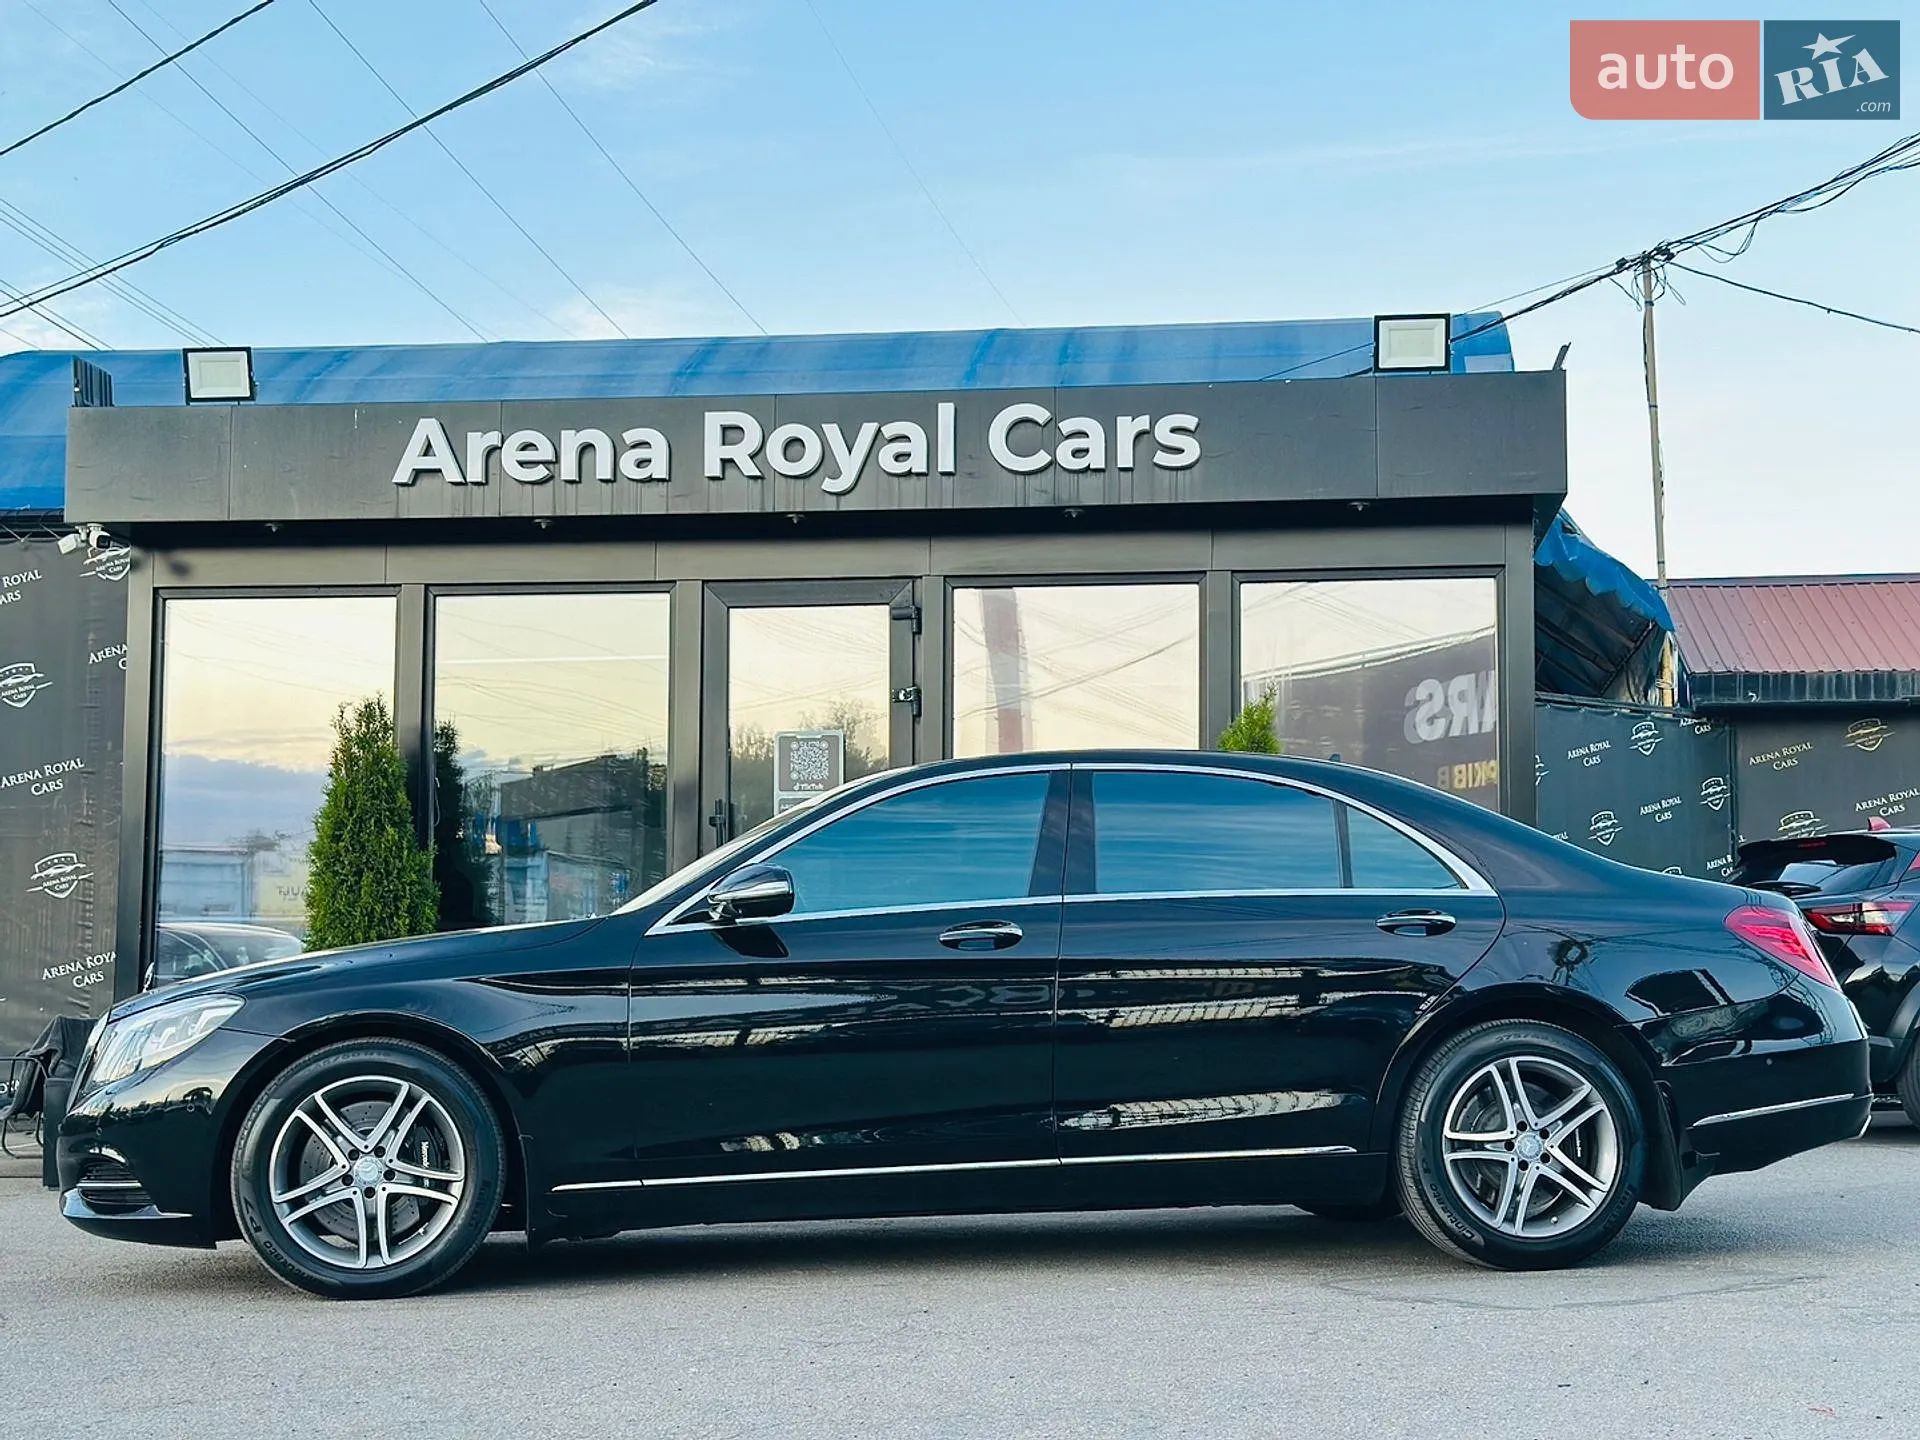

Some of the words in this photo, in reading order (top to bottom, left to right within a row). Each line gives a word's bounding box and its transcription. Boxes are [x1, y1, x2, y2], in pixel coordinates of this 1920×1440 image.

[393, 417, 670, 486] Arena
[703, 401, 956, 494] Royal
[987, 402, 1202, 474] Cars
[2, 569, 43, 588] ROYAL
[0, 589, 22, 605] ARS
[88, 643, 128, 665] ARENA
[1567, 746, 1590, 760] ARENA
[1590, 739, 1612, 753] ROYAL
[1749, 752, 1781, 766] ARENA
[1782, 741, 1813, 756] ROYAL
[1582, 754, 1601, 767] CARS
[1773, 757, 1799, 771] CARS
[0, 769, 43, 789] ARENA
[44, 757, 85, 777] ROYAL
[31, 778, 64, 797] CARS
[1639, 804, 1662, 816] ARENA
[1662, 795, 1682, 809] ROYAL
[1855, 796, 1889, 812] ARENA
[1888, 787, 1920, 803] ROYAL
[1654, 811, 1673, 823] CARS
[1879, 803, 1906, 817] CARS
[42, 960, 85, 981] ARENA
[86, 951, 117, 970] ROYA
[72, 970, 105, 988] CARS
